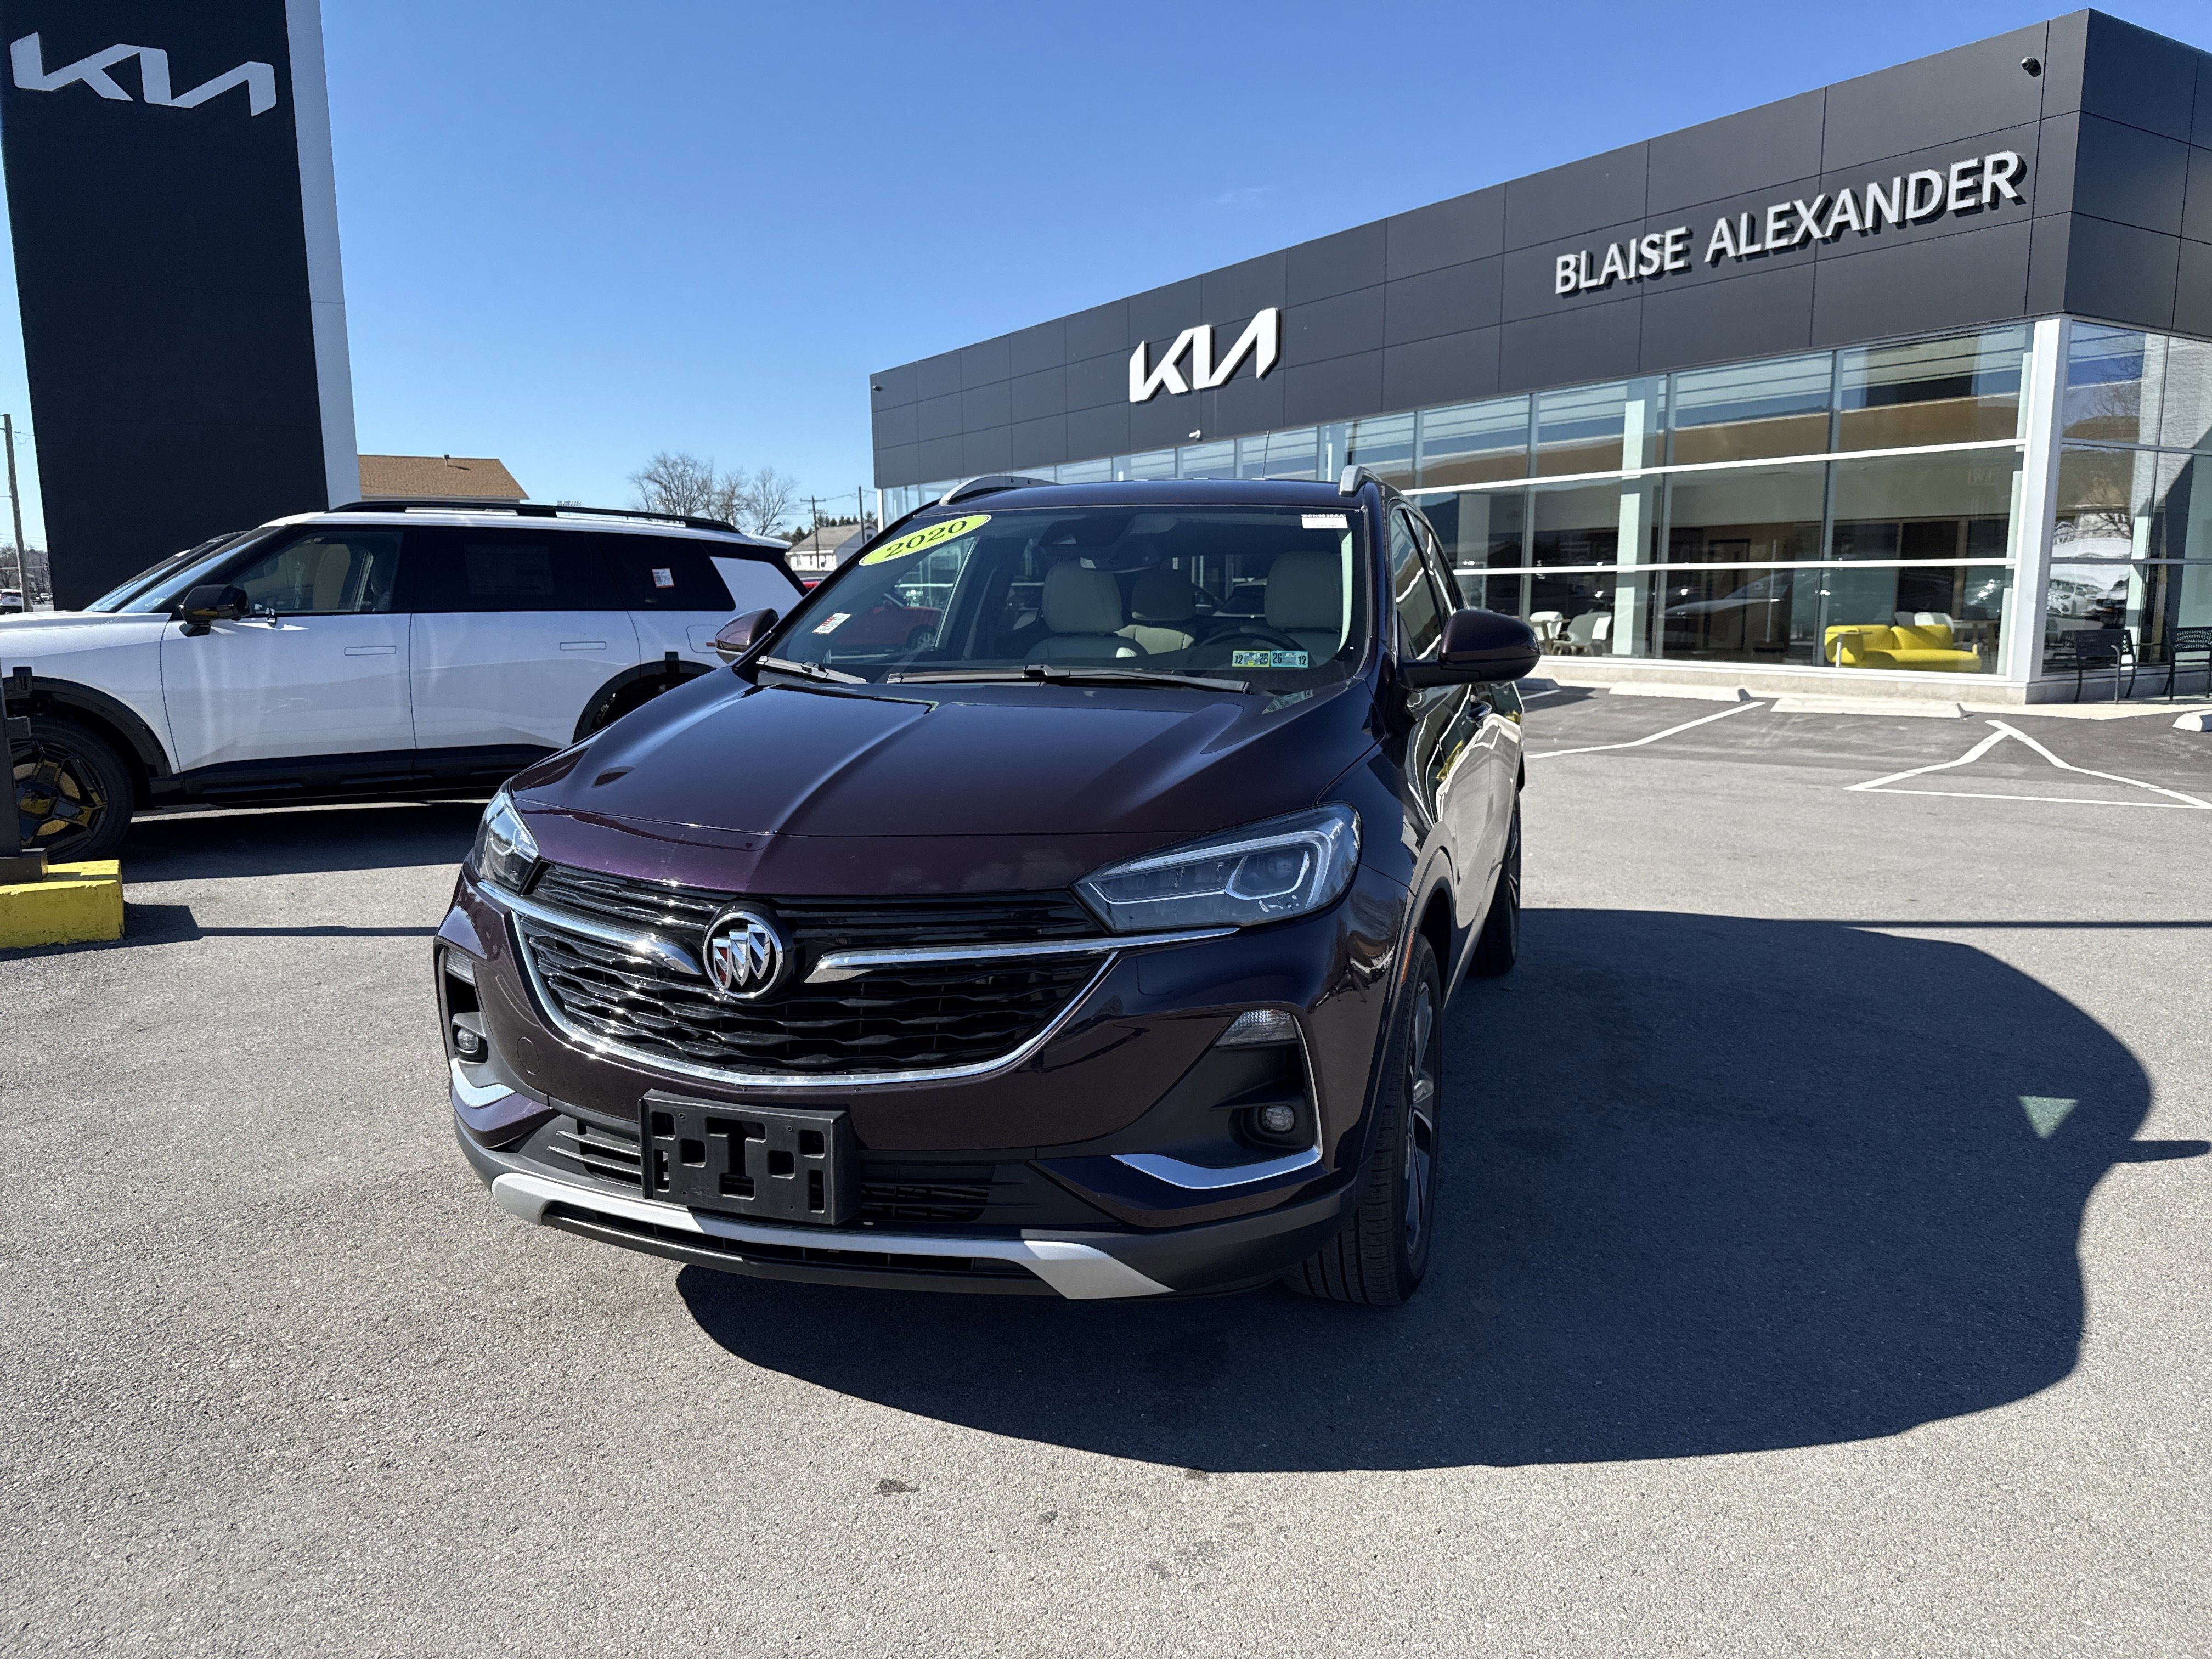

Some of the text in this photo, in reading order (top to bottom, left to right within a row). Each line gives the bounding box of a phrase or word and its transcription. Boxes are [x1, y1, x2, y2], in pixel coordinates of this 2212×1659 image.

[10, 31, 276, 117] KIA
[1555, 149, 2024, 295] BLAISE ALEXANDER
[1129, 307, 1279, 403] KIA
[884, 520, 967, 558] 2020
[1234, 654, 1244, 664] 12
[1272, 652, 1307, 665] 26 12
